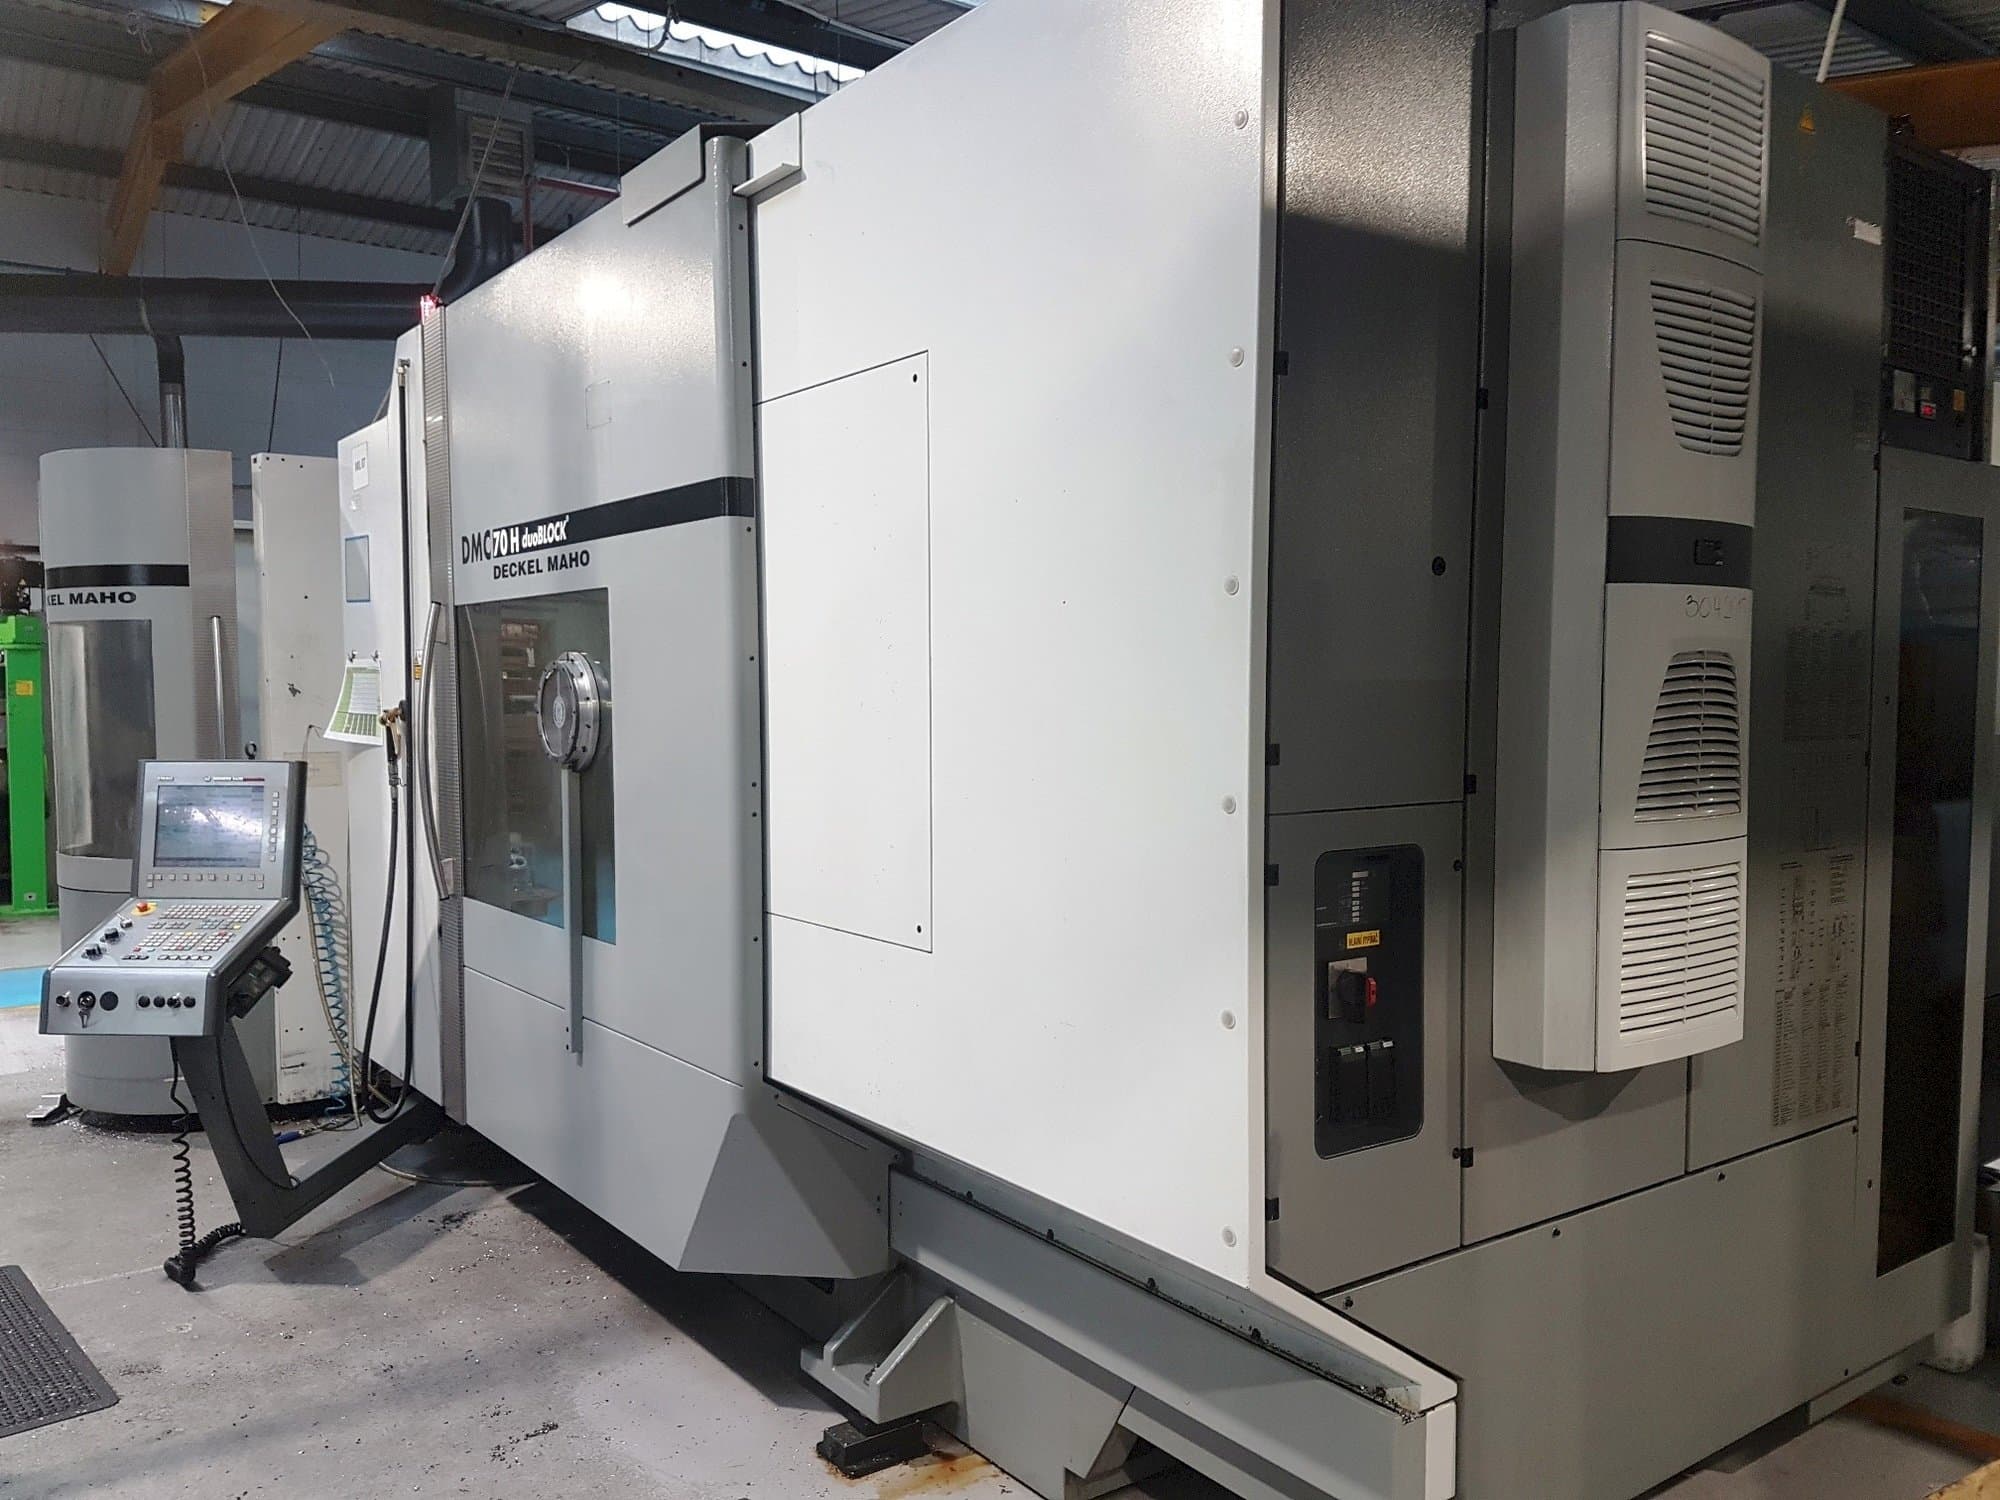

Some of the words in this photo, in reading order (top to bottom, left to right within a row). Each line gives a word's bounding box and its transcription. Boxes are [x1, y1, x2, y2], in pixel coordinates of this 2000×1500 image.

[493, 557, 544, 580] DECKEL
[547, 549, 590, 572] MAHO
[69, 591, 137, 605] MAHO
